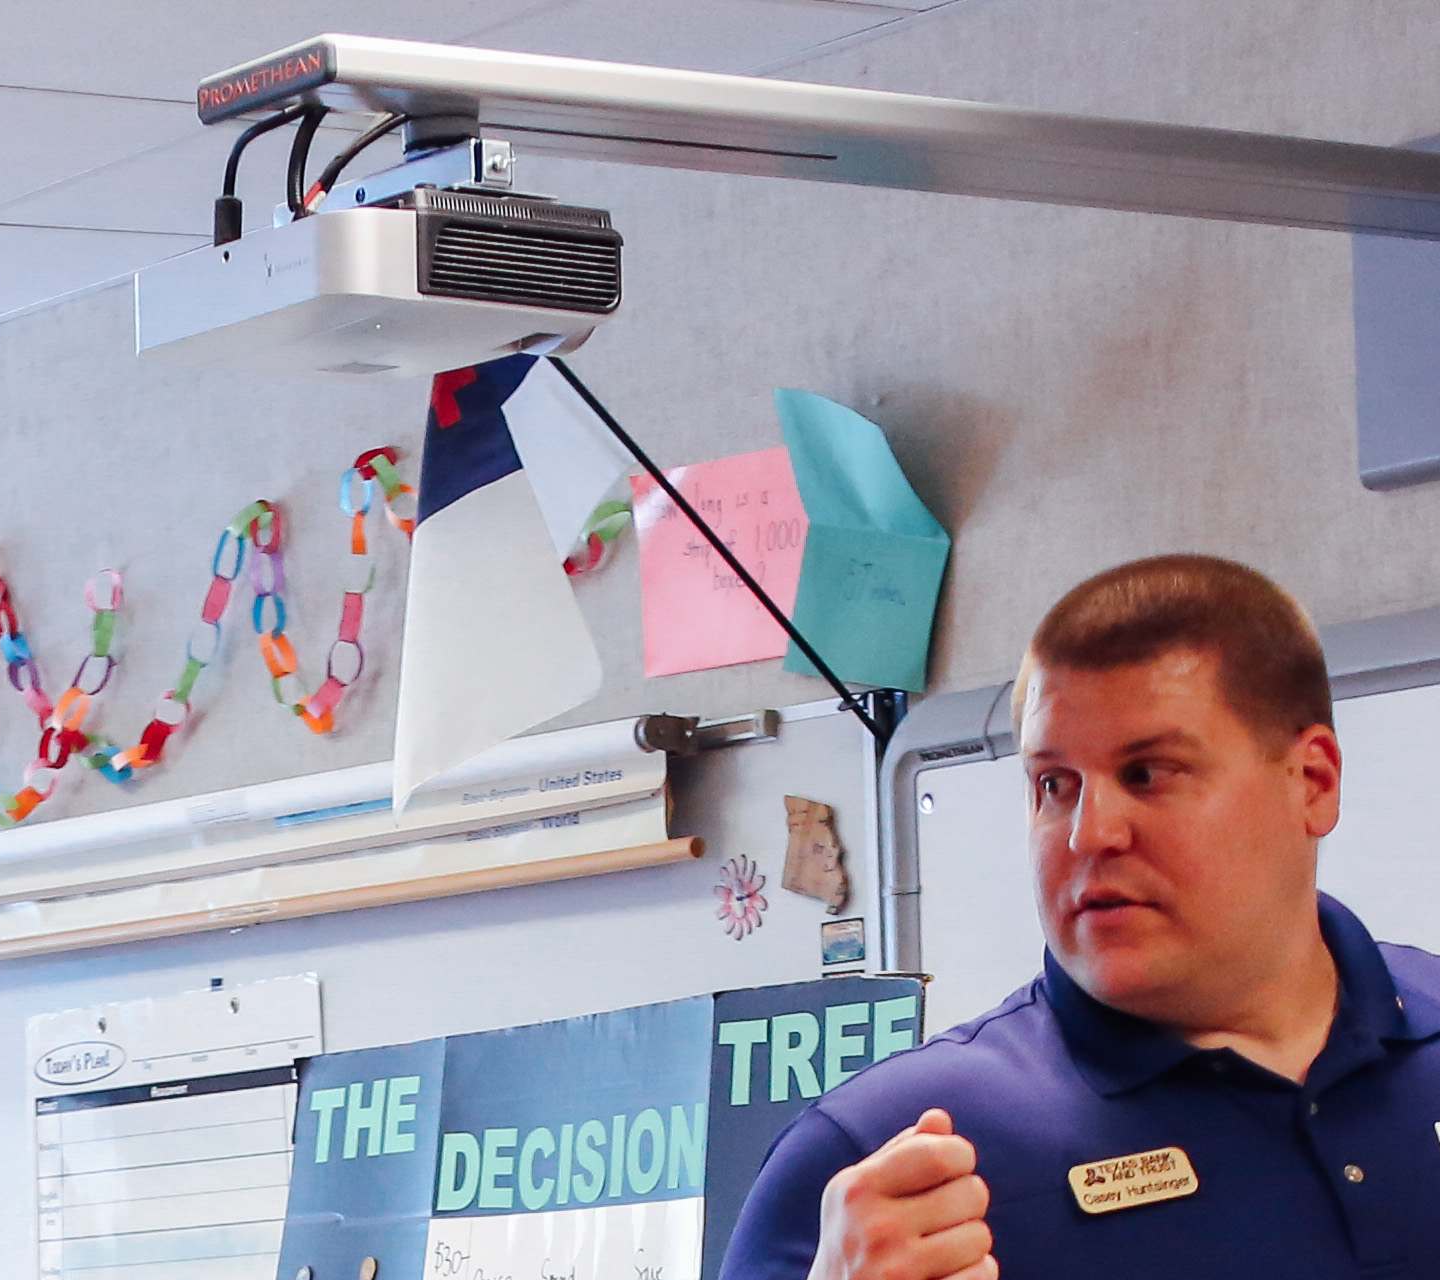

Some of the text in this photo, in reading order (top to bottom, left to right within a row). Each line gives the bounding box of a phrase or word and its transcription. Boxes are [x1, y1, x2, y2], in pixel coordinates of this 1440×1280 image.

[199, 50, 322, 110] PROMETHEAN
[539, 773, 580, 792] United
[583, 768, 623, 786] States
[717, 994, 917, 1107] TREE
[309, 1074, 421, 1164] THE
[435, 1103, 708, 1213] DECISION
[1083, 1176, 1190, 1206] Casey Huntsinger
